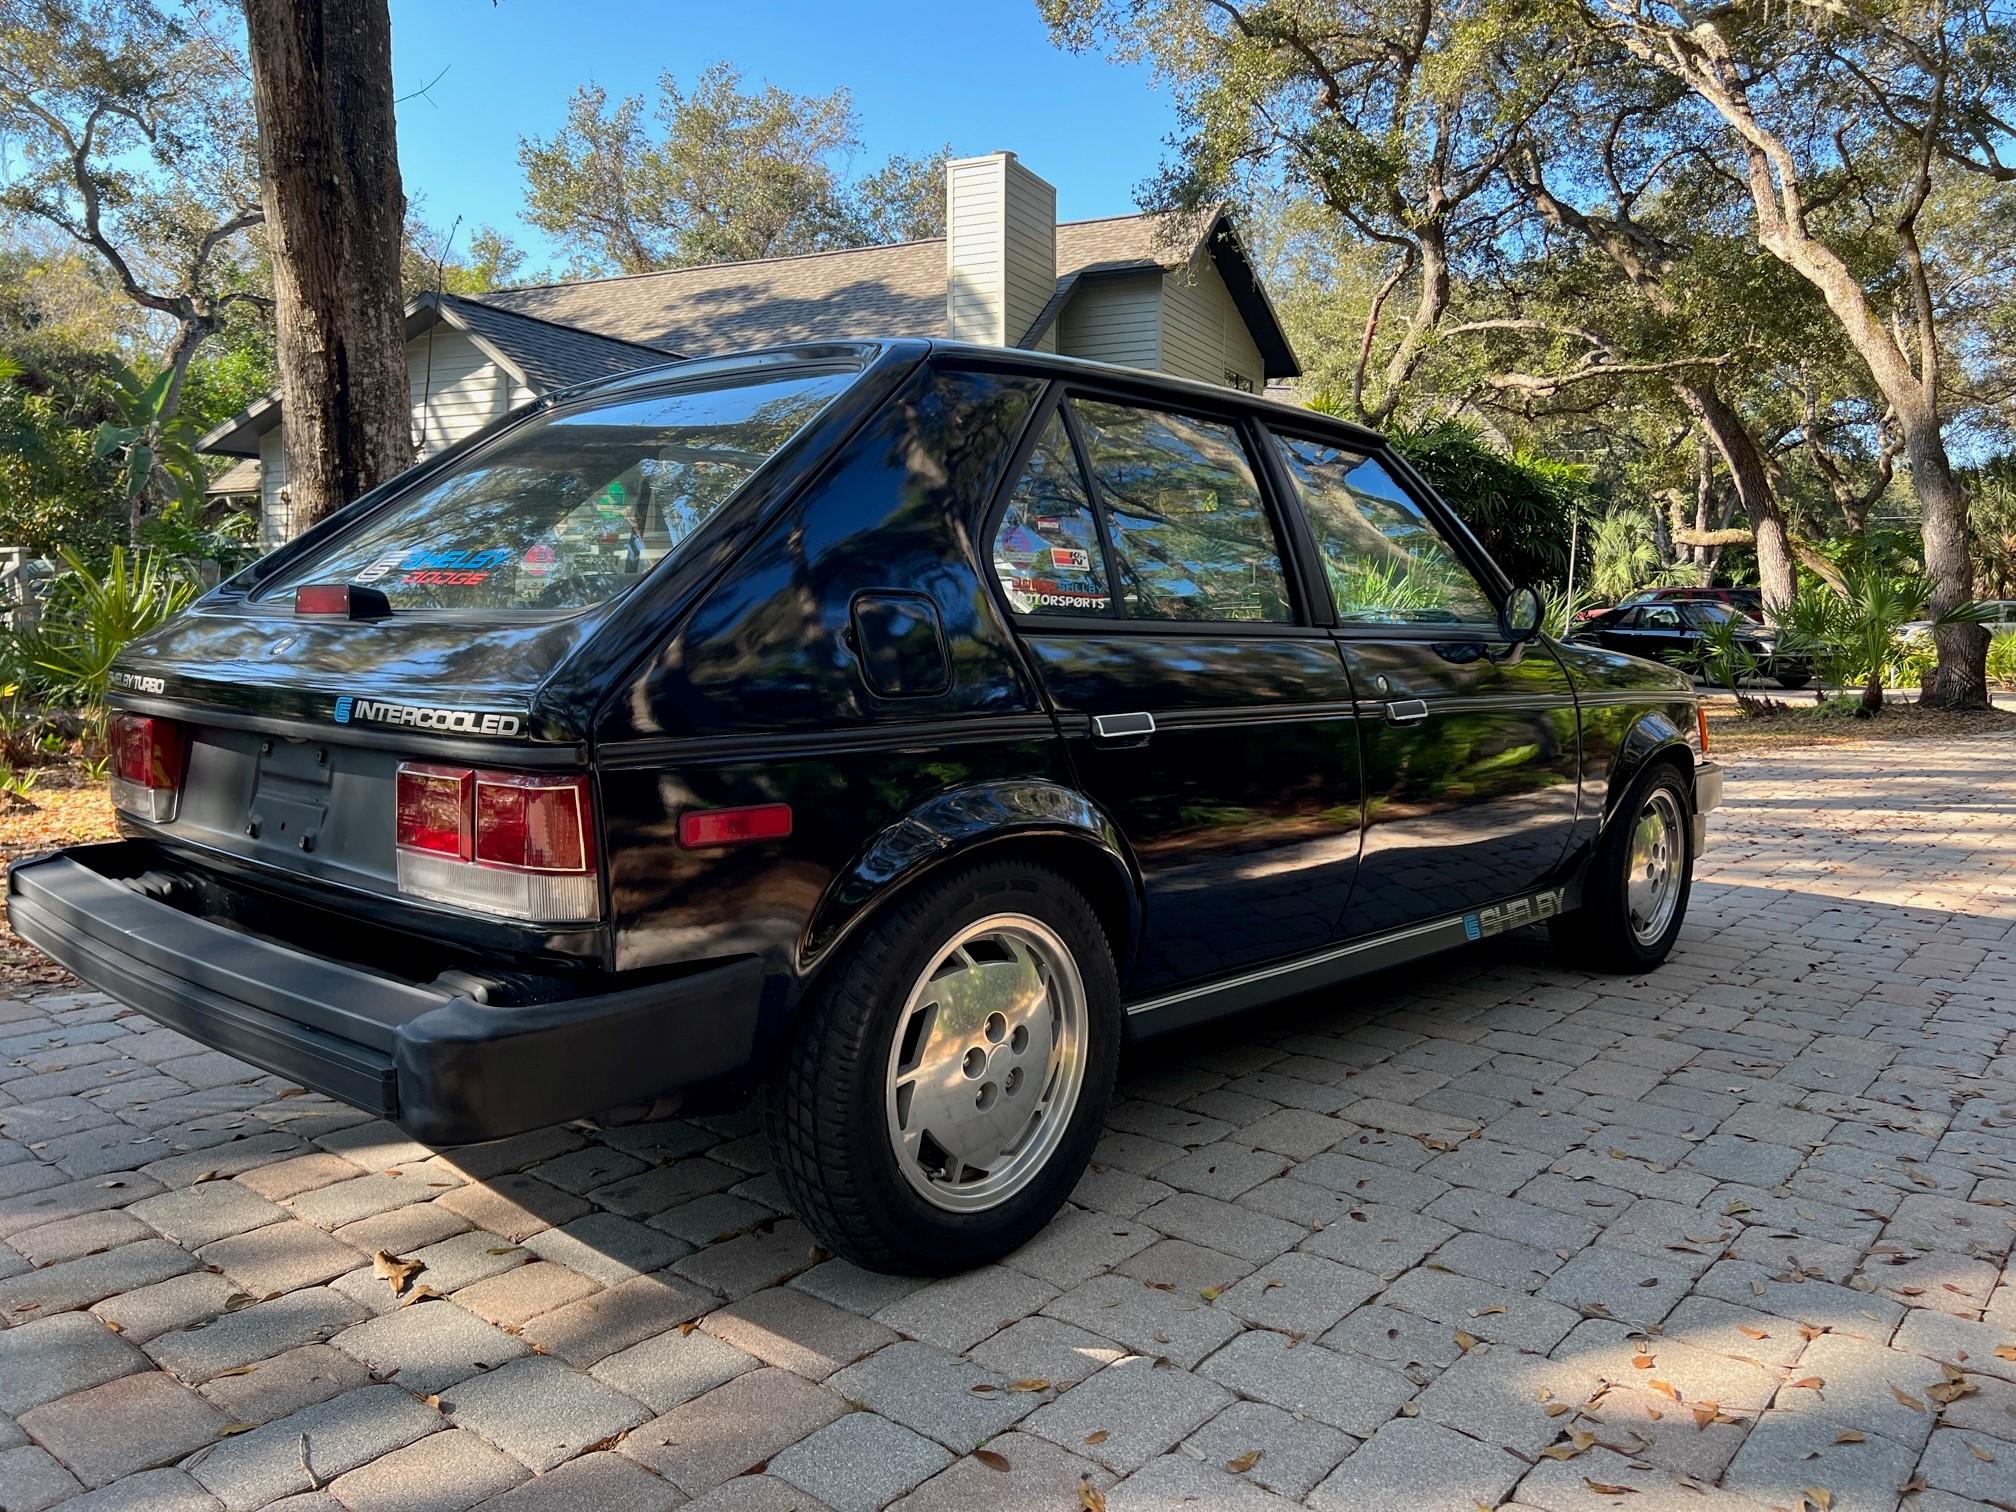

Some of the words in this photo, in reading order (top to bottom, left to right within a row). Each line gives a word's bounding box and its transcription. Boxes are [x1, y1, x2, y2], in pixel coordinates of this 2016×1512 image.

[400, 549, 517, 570] SHELBY
[400, 571, 490, 586] DODGE
[134, 675, 165, 694] TURBO
[354, 700, 520, 736] INTERCOOLED
[1480, 887, 1566, 937] SHELBY
